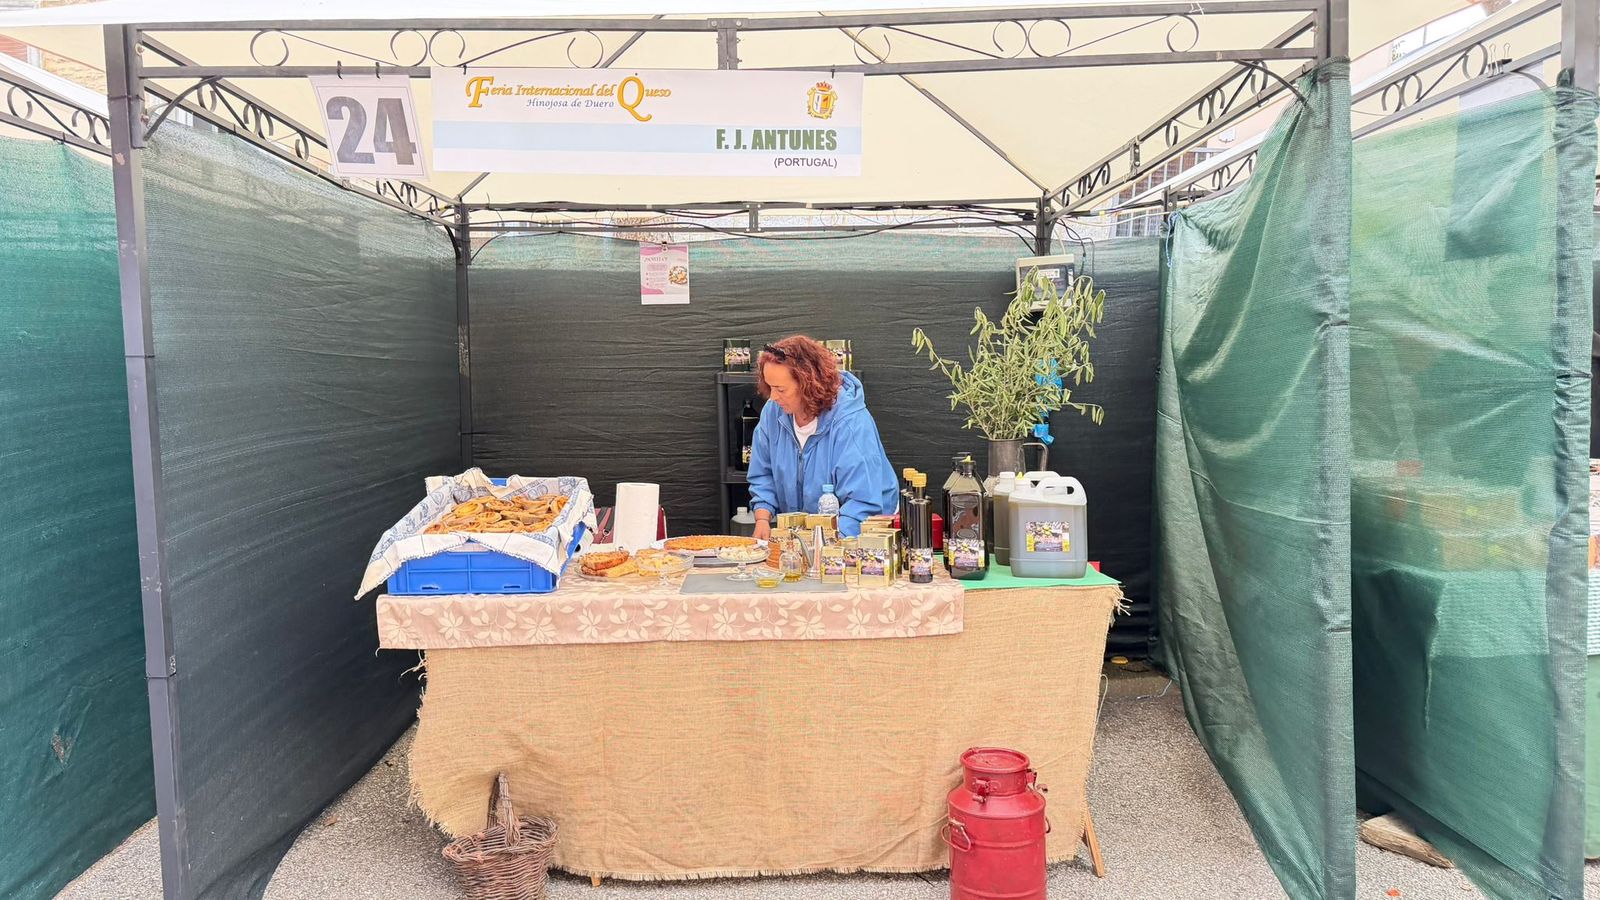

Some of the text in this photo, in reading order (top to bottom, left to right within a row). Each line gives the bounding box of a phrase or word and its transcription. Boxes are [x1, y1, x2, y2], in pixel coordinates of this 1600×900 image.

[465, 76, 672, 122] Feria Internacional del Queso
[526, 98, 615, 110] Hinojosa de Duero
[326, 96, 417, 165] 24
[716, 129, 837, 151] F. J. ANTUNES
[774, 158, 838, 169] (PORTUGAL)
